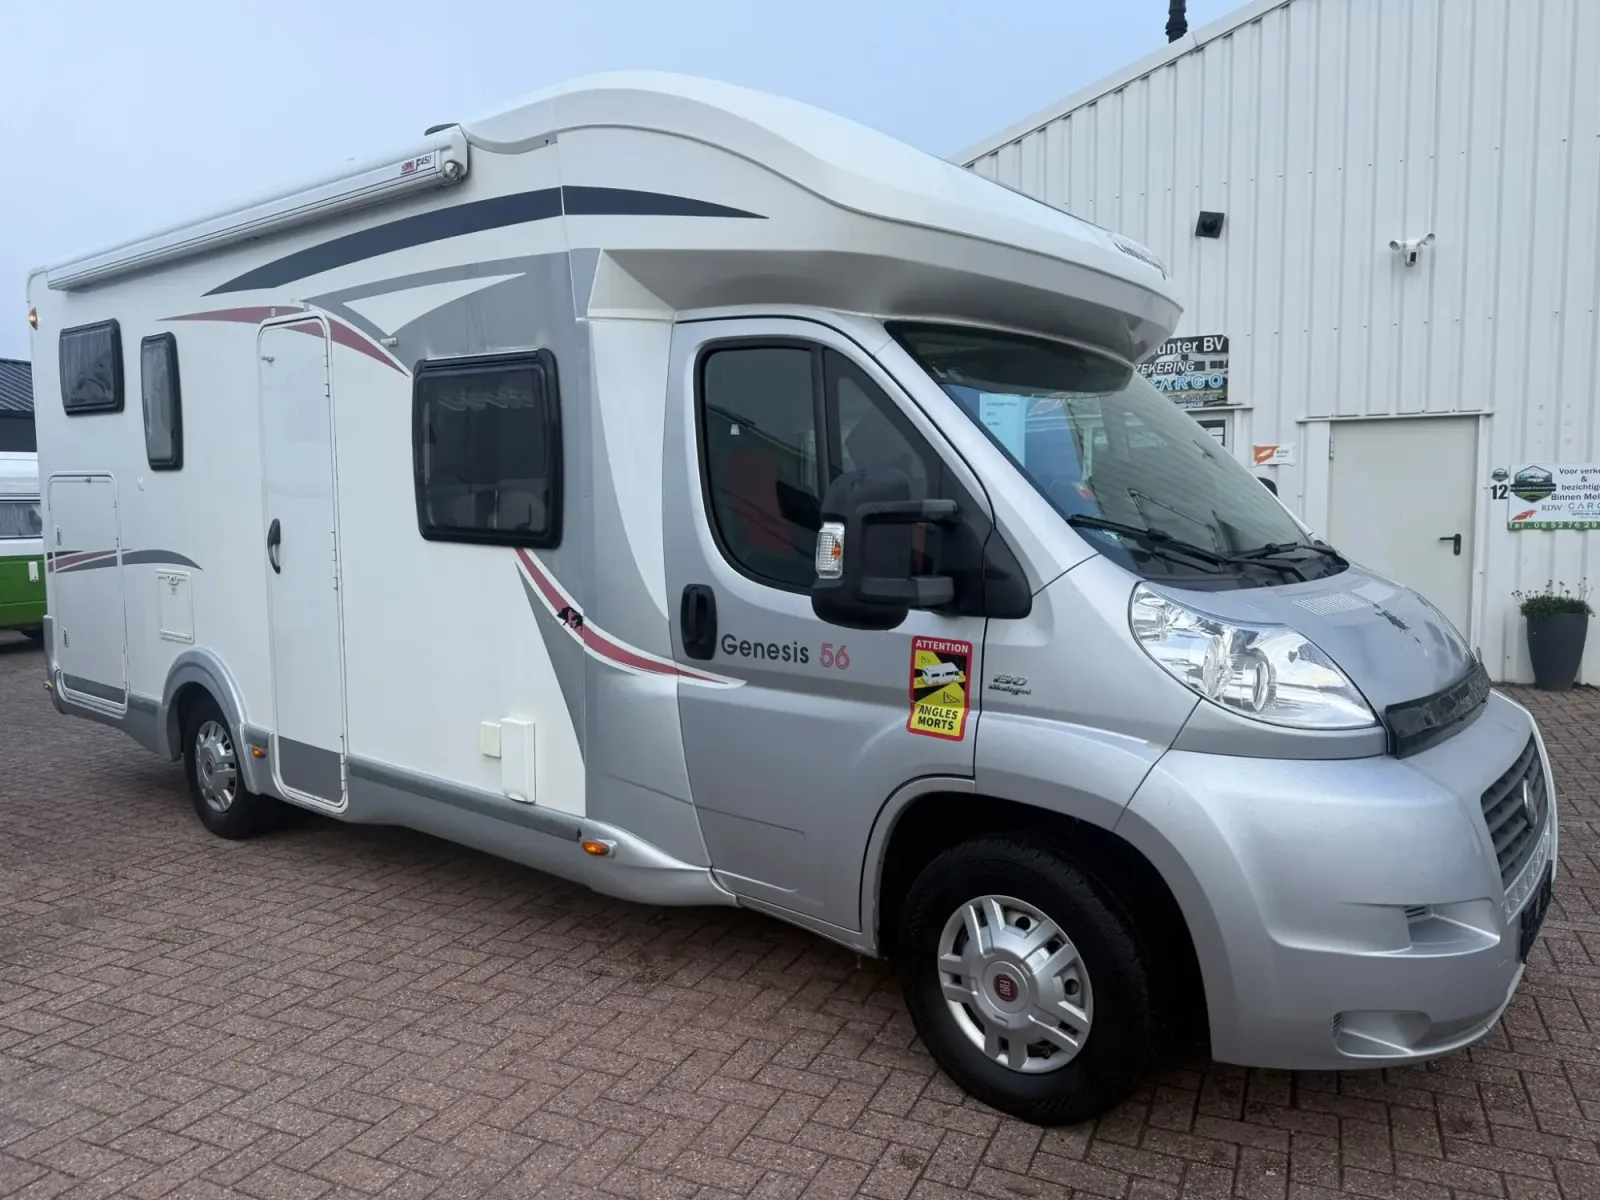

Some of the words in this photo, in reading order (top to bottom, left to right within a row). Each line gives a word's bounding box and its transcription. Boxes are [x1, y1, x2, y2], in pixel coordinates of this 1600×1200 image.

[1156, 340, 1199, 355] unter
[1203, 337, 1225, 352] BV
[1559, 467, 1578, 475] Voor
[1490, 484, 1509, 500] 12
[1551, 493, 1582, 501] Binnen
[721, 633, 810, 664] Genesis
[820, 642, 850, 669] 56
[916, 639, 968, 653] ATTENTION
[918, 704, 958, 720] ANGLES
[917, 715, 954, 731] MORTS
